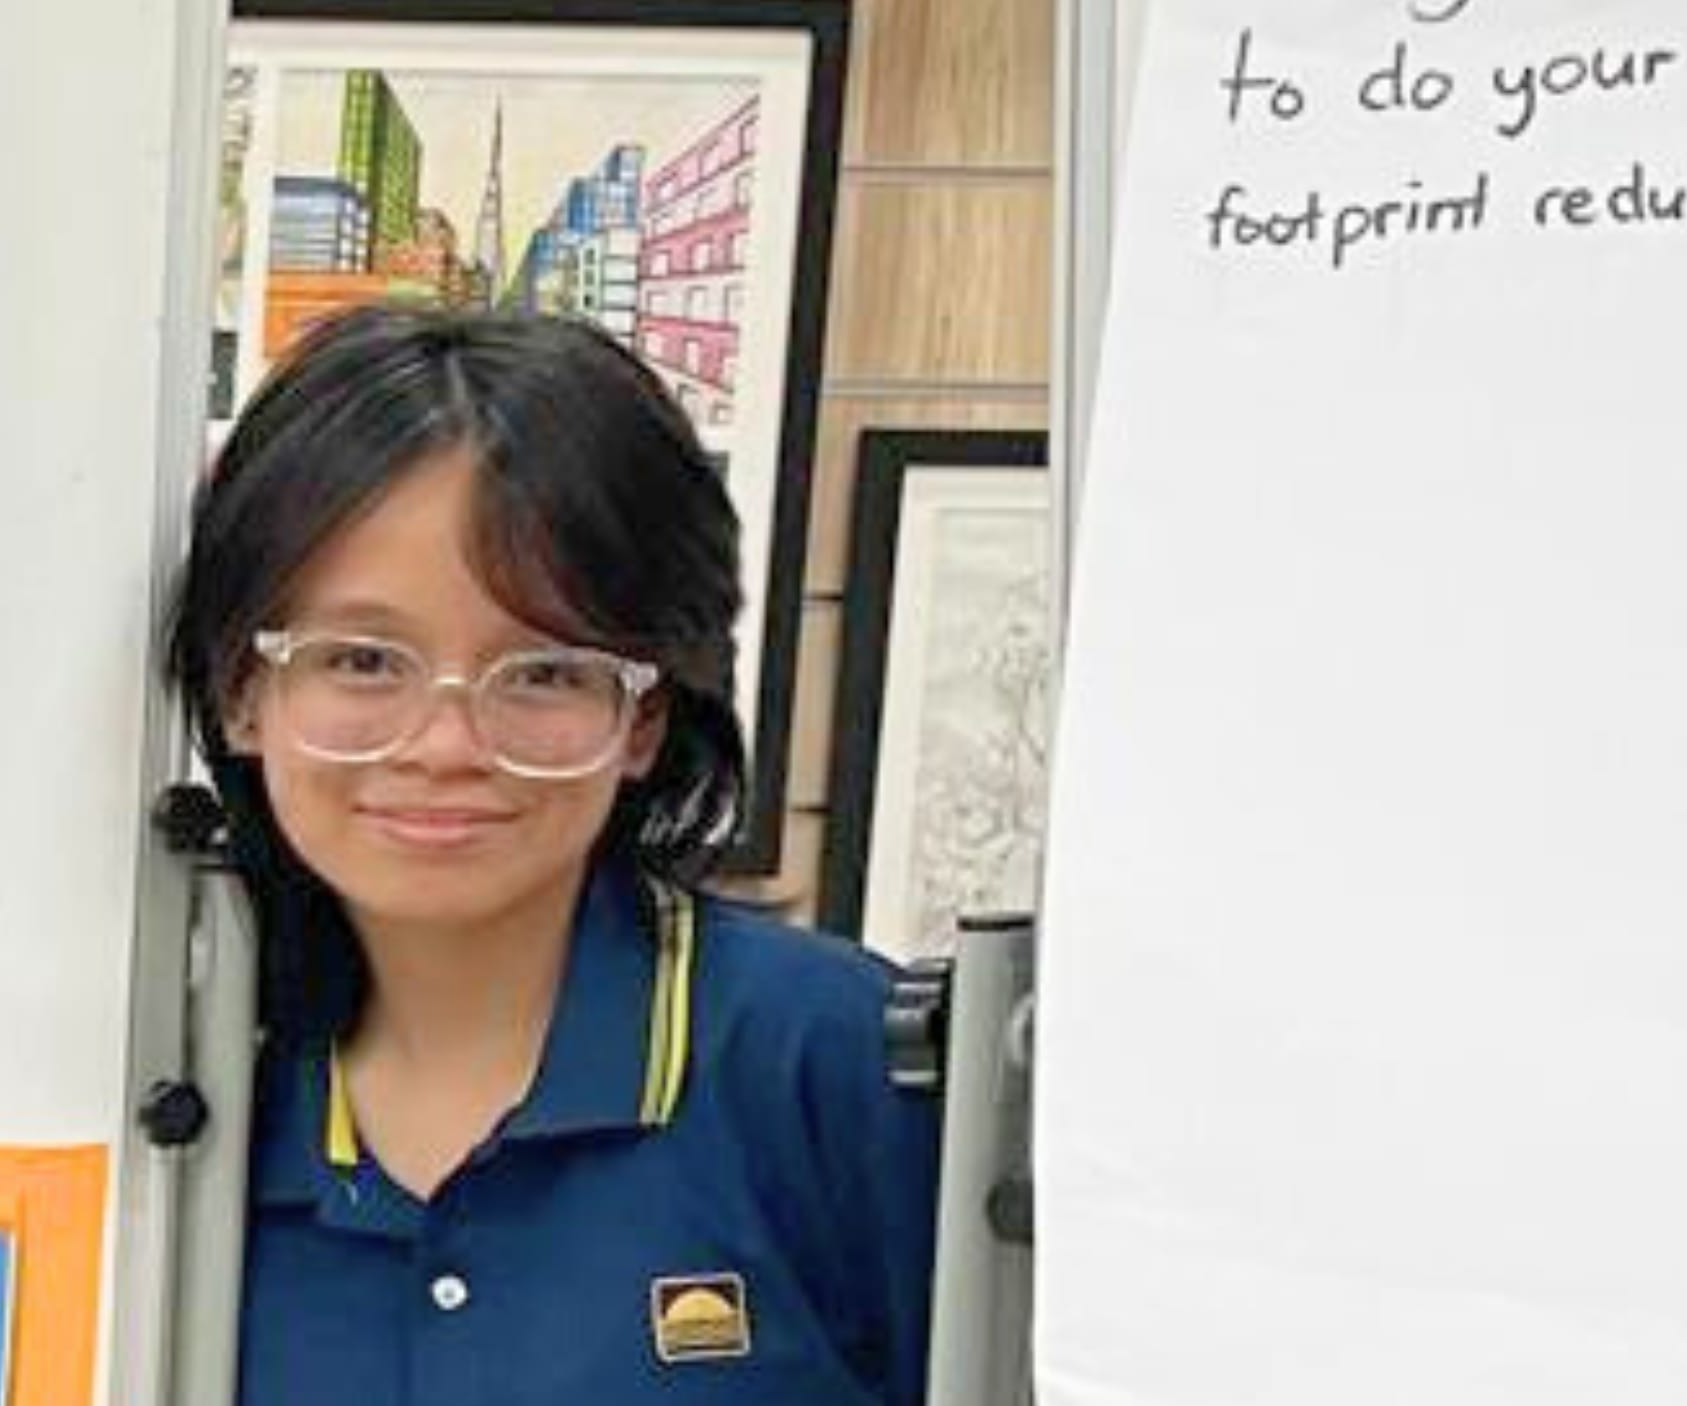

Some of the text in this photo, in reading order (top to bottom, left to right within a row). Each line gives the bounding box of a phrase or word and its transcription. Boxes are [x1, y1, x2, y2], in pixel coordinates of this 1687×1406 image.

[1220, 28, 1678, 140] to do your
[1204, 171, 1490, 270] footprint
